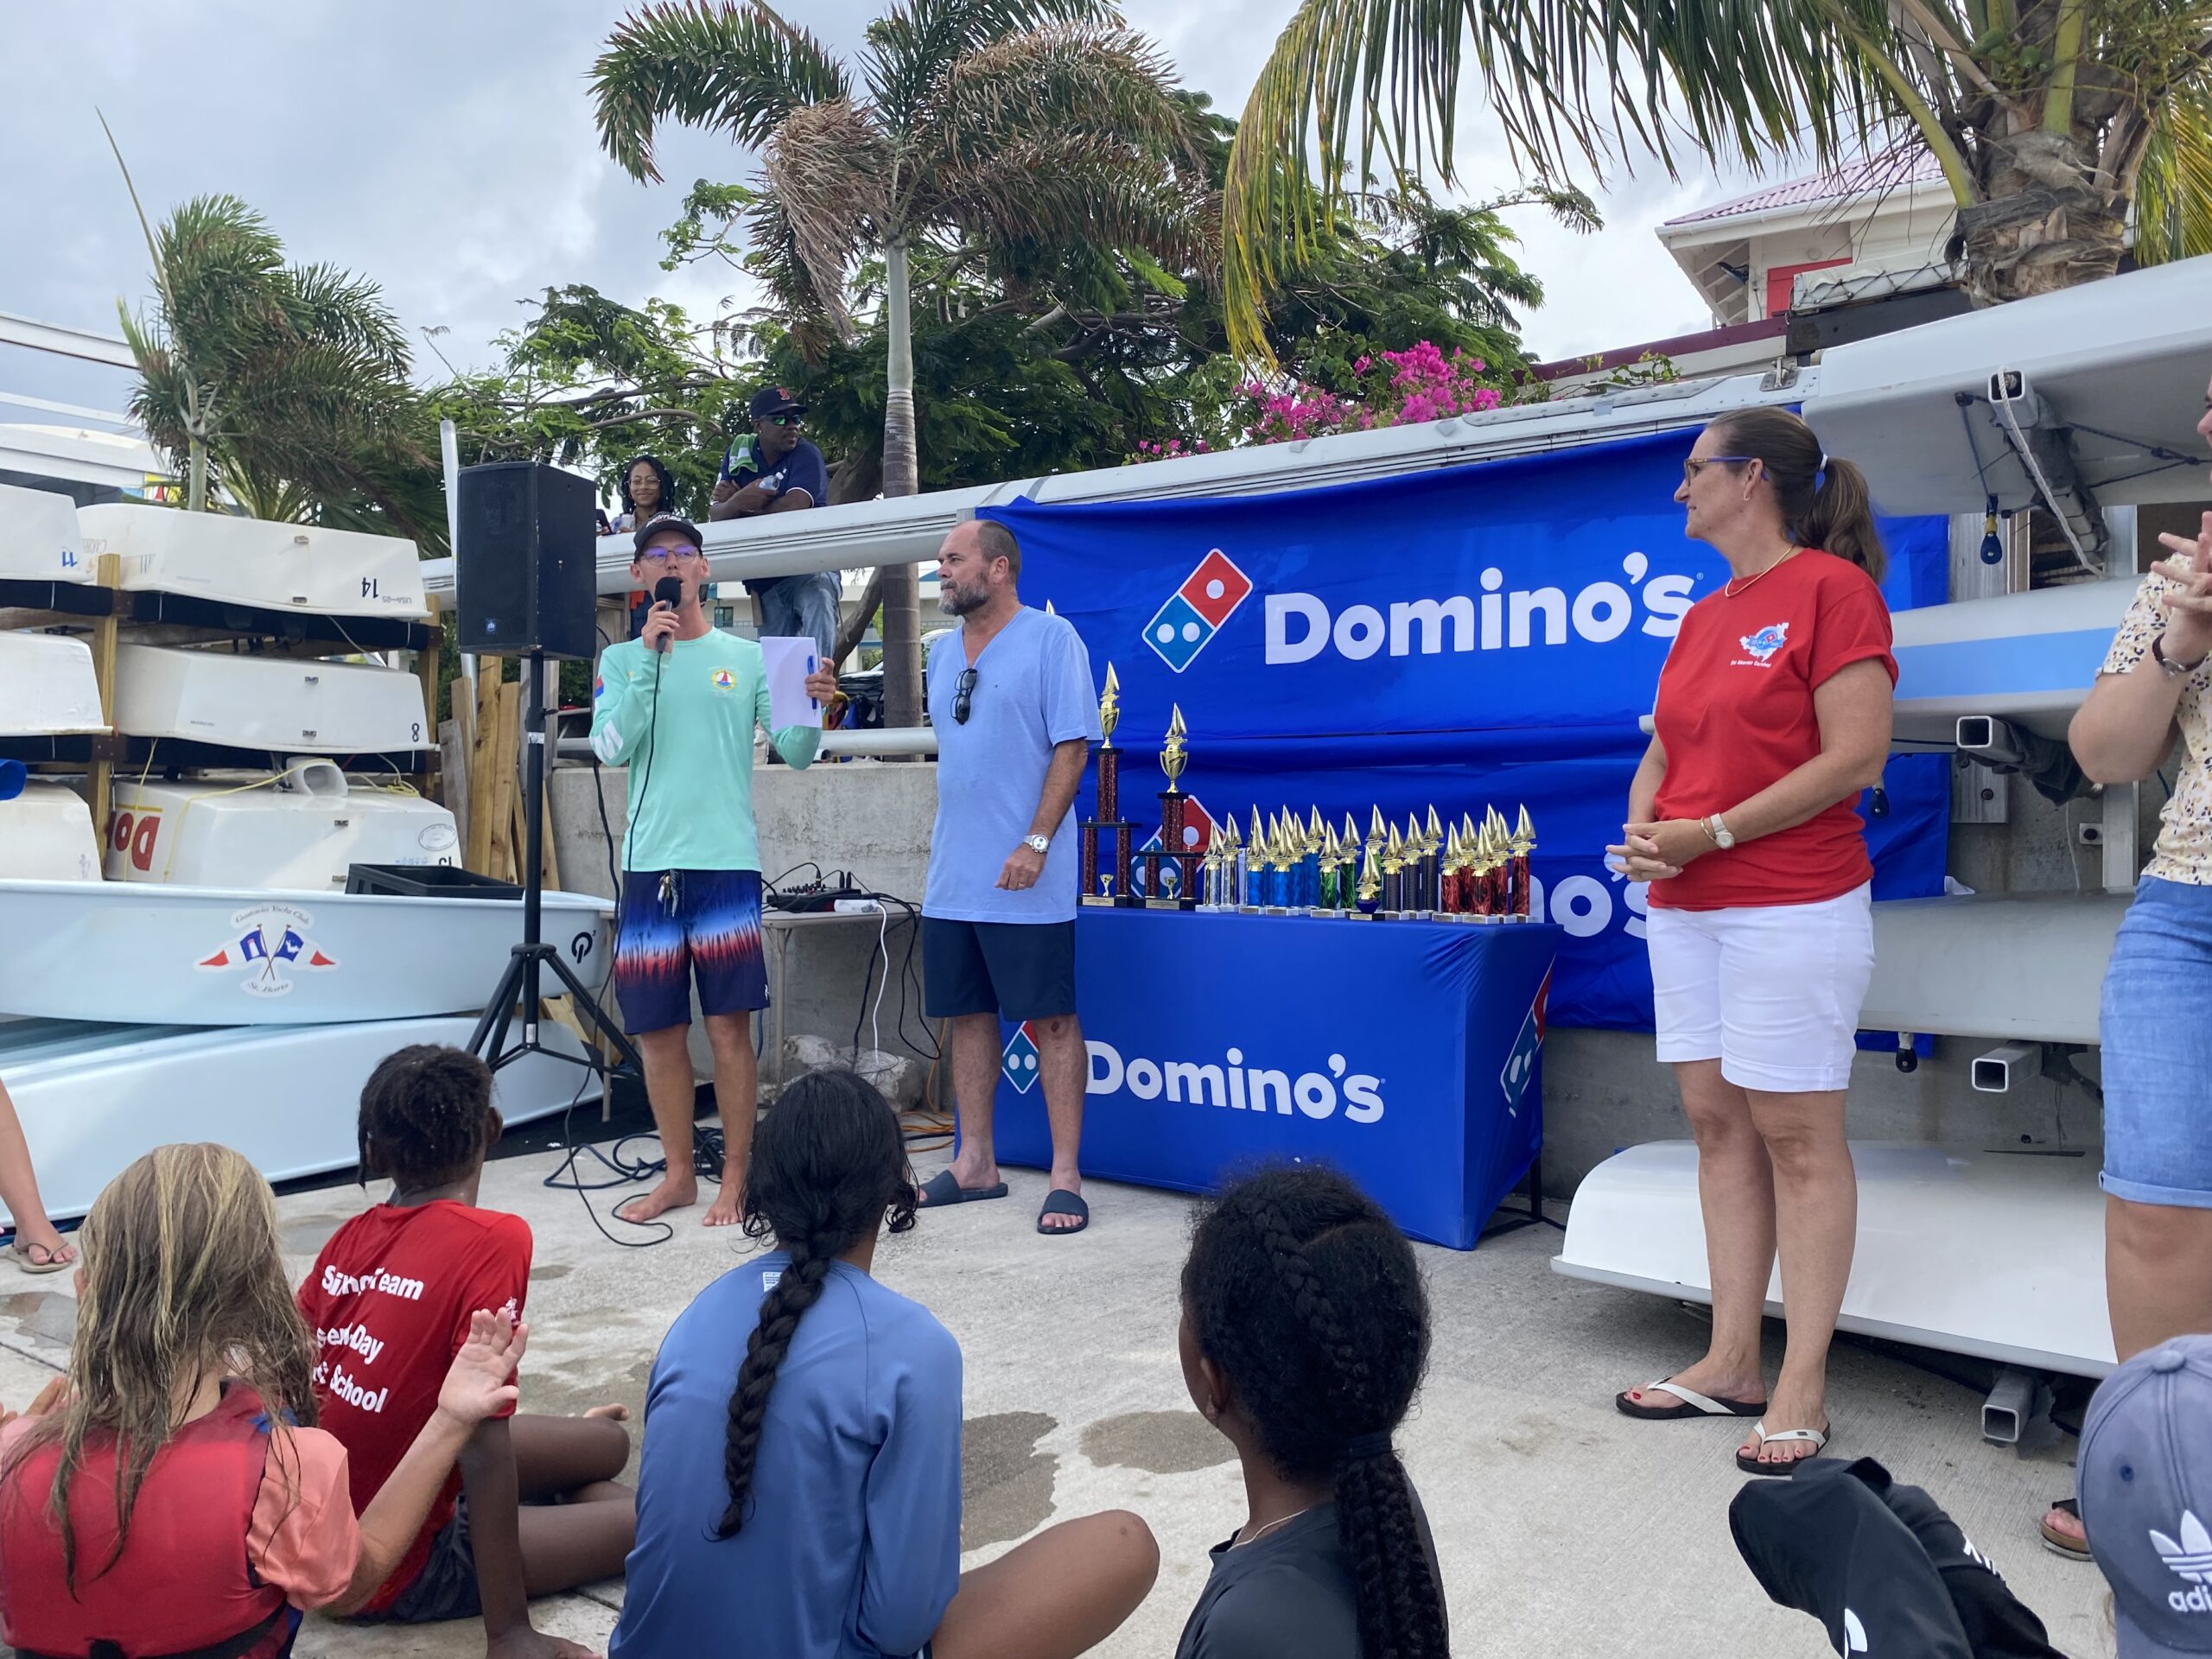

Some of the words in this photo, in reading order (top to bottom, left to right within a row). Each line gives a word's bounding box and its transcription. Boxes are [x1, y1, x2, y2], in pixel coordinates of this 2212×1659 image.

[61, 550, 79, 568] 11
[361, 577, 379, 599] 14
[1265, 551, 1695, 665] Domino's
[411, 722, 420, 742] 8
[271, 905, 292, 914] Yacht
[292, 907, 309, 925] Club
[1084, 1039, 1385, 1123] Domino's
[329, 1363, 389, 1414] School
